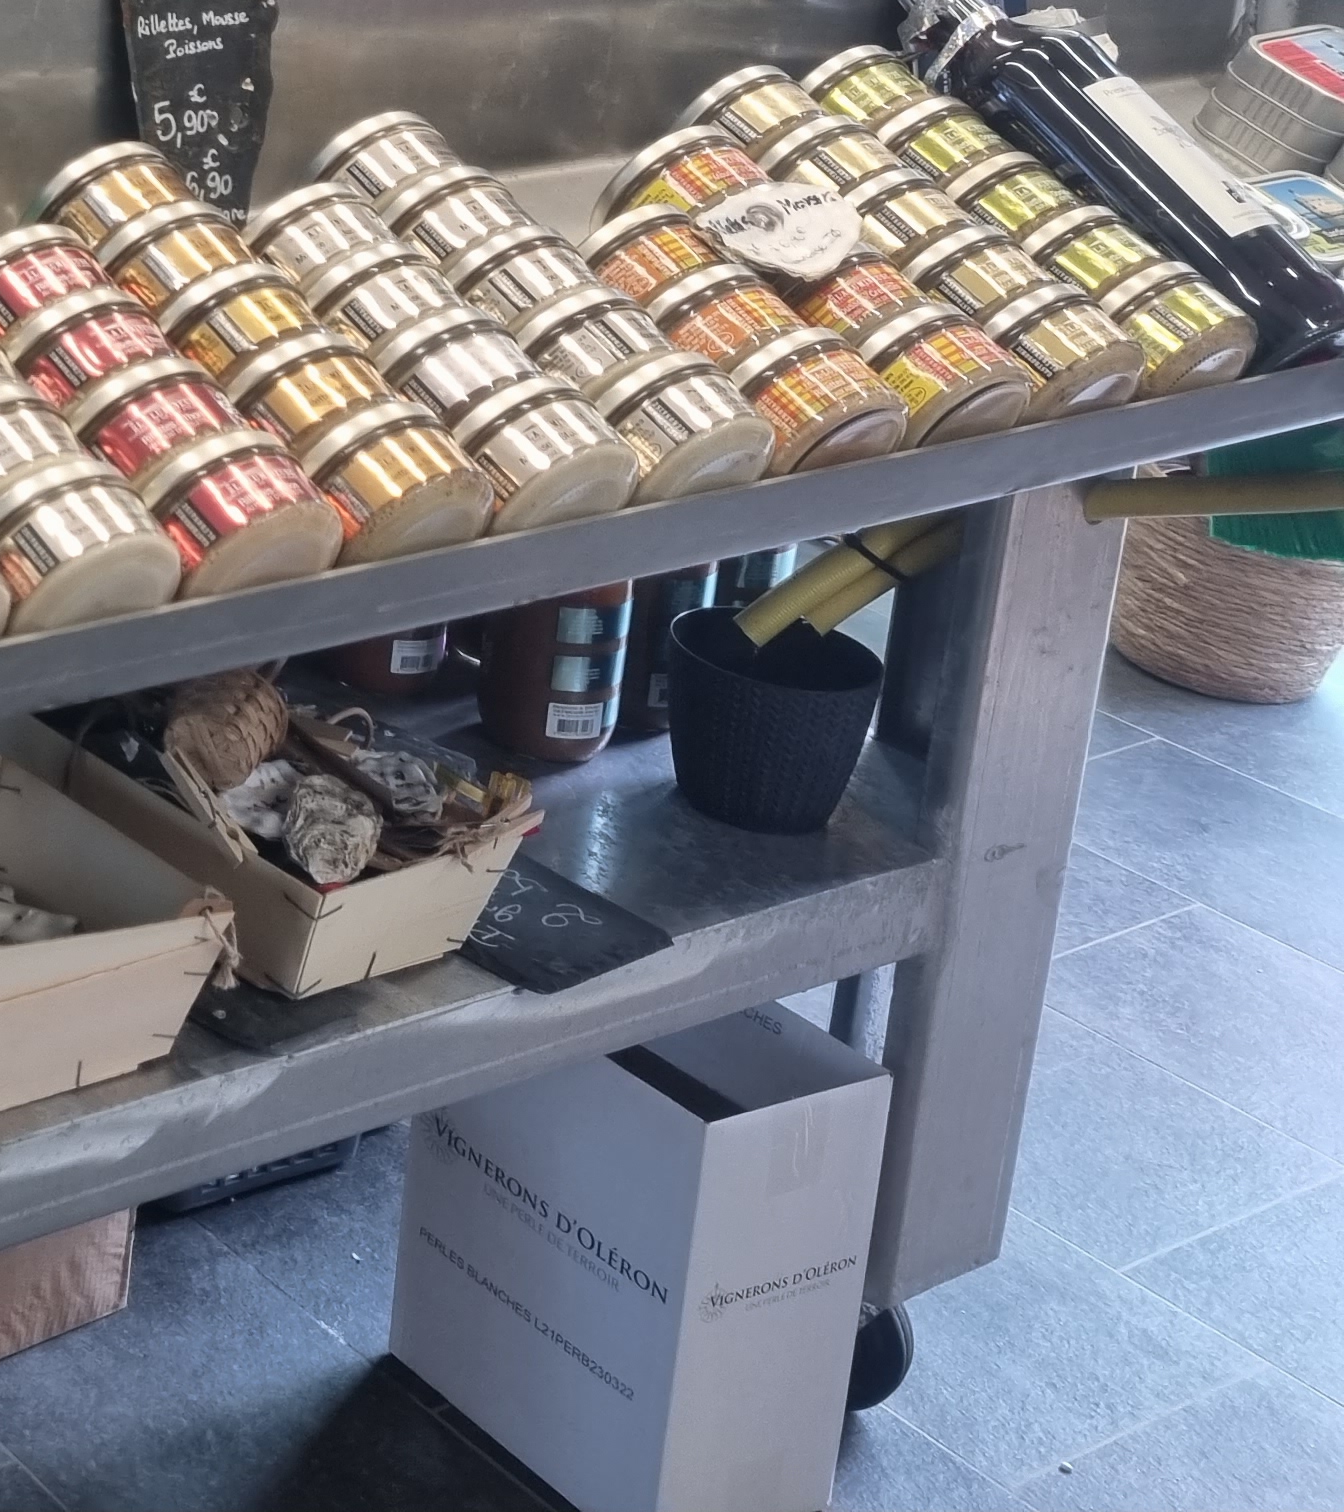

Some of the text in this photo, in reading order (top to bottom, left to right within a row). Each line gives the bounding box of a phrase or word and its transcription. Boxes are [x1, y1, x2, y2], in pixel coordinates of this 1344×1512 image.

[201, 8, 250, 27] Mousse
[164, 35, 224, 59] Poissons
[742, 1007, 783, 1035] CHES
[434, 1114, 669, 1306] VIGNERONS D'OLÉRON
[565, 1244, 621, 1293] TERROIR
[710, 1255, 857, 1308] VIGNERONS D'OLÉRON
[419, 1226, 635, 1402] PERLES BLANCHES L21PERB230322
